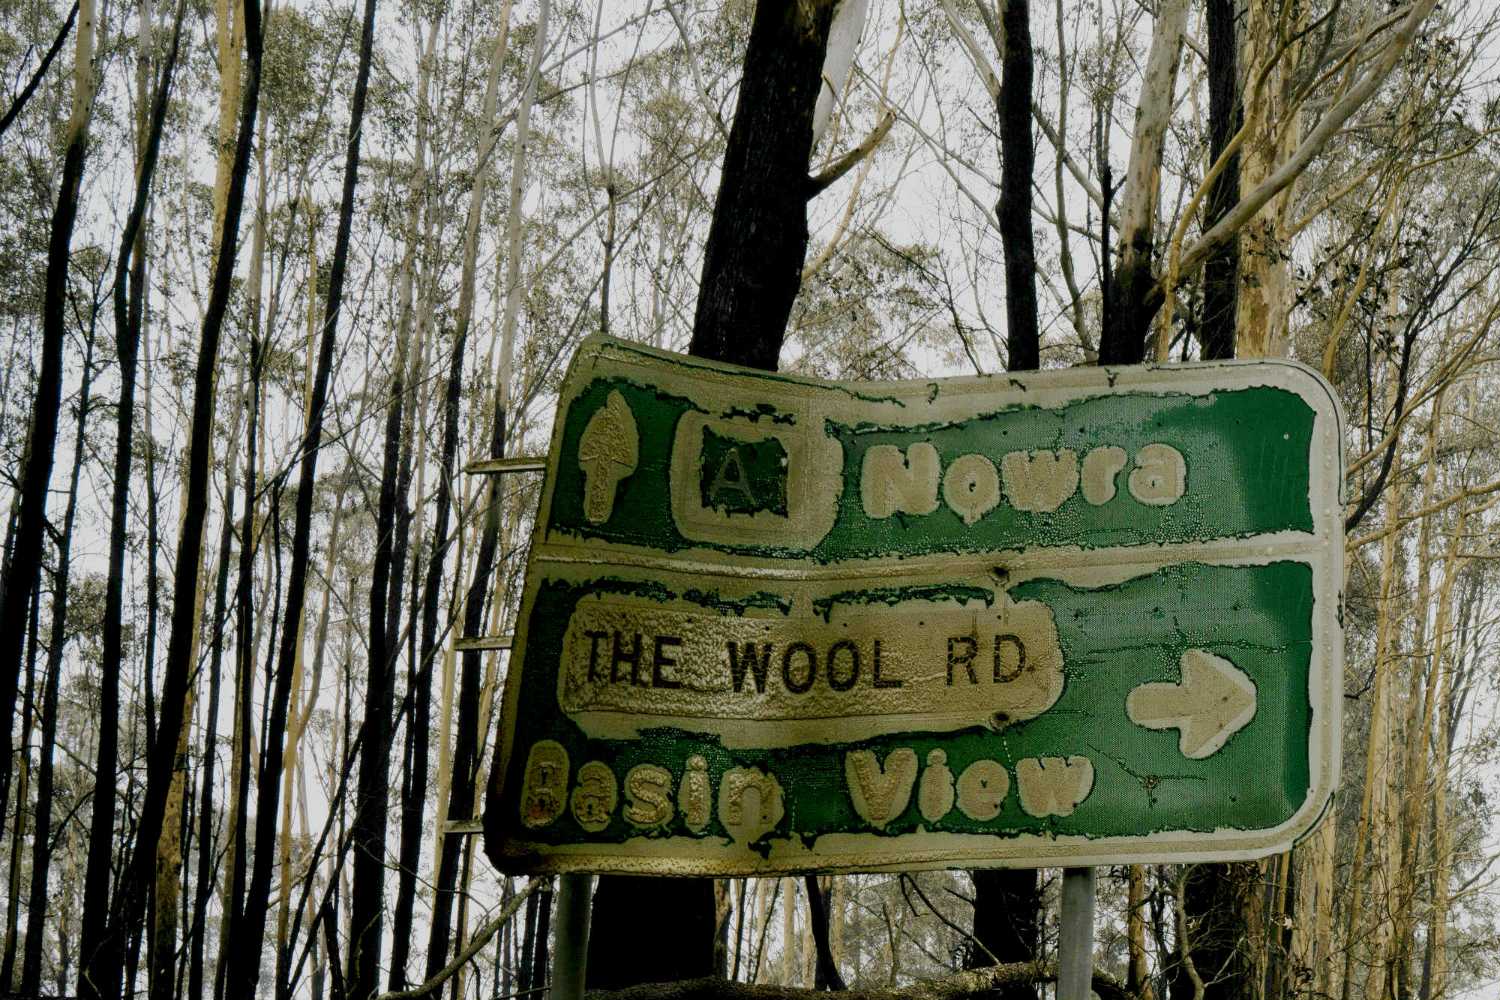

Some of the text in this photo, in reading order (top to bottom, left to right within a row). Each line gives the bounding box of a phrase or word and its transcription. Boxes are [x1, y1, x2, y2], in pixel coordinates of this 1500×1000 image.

[860, 442, 1187, 520] Nowra
[584, 630, 1027, 694] THE WOOL RD
[520, 740, 1094, 838] Basin View
